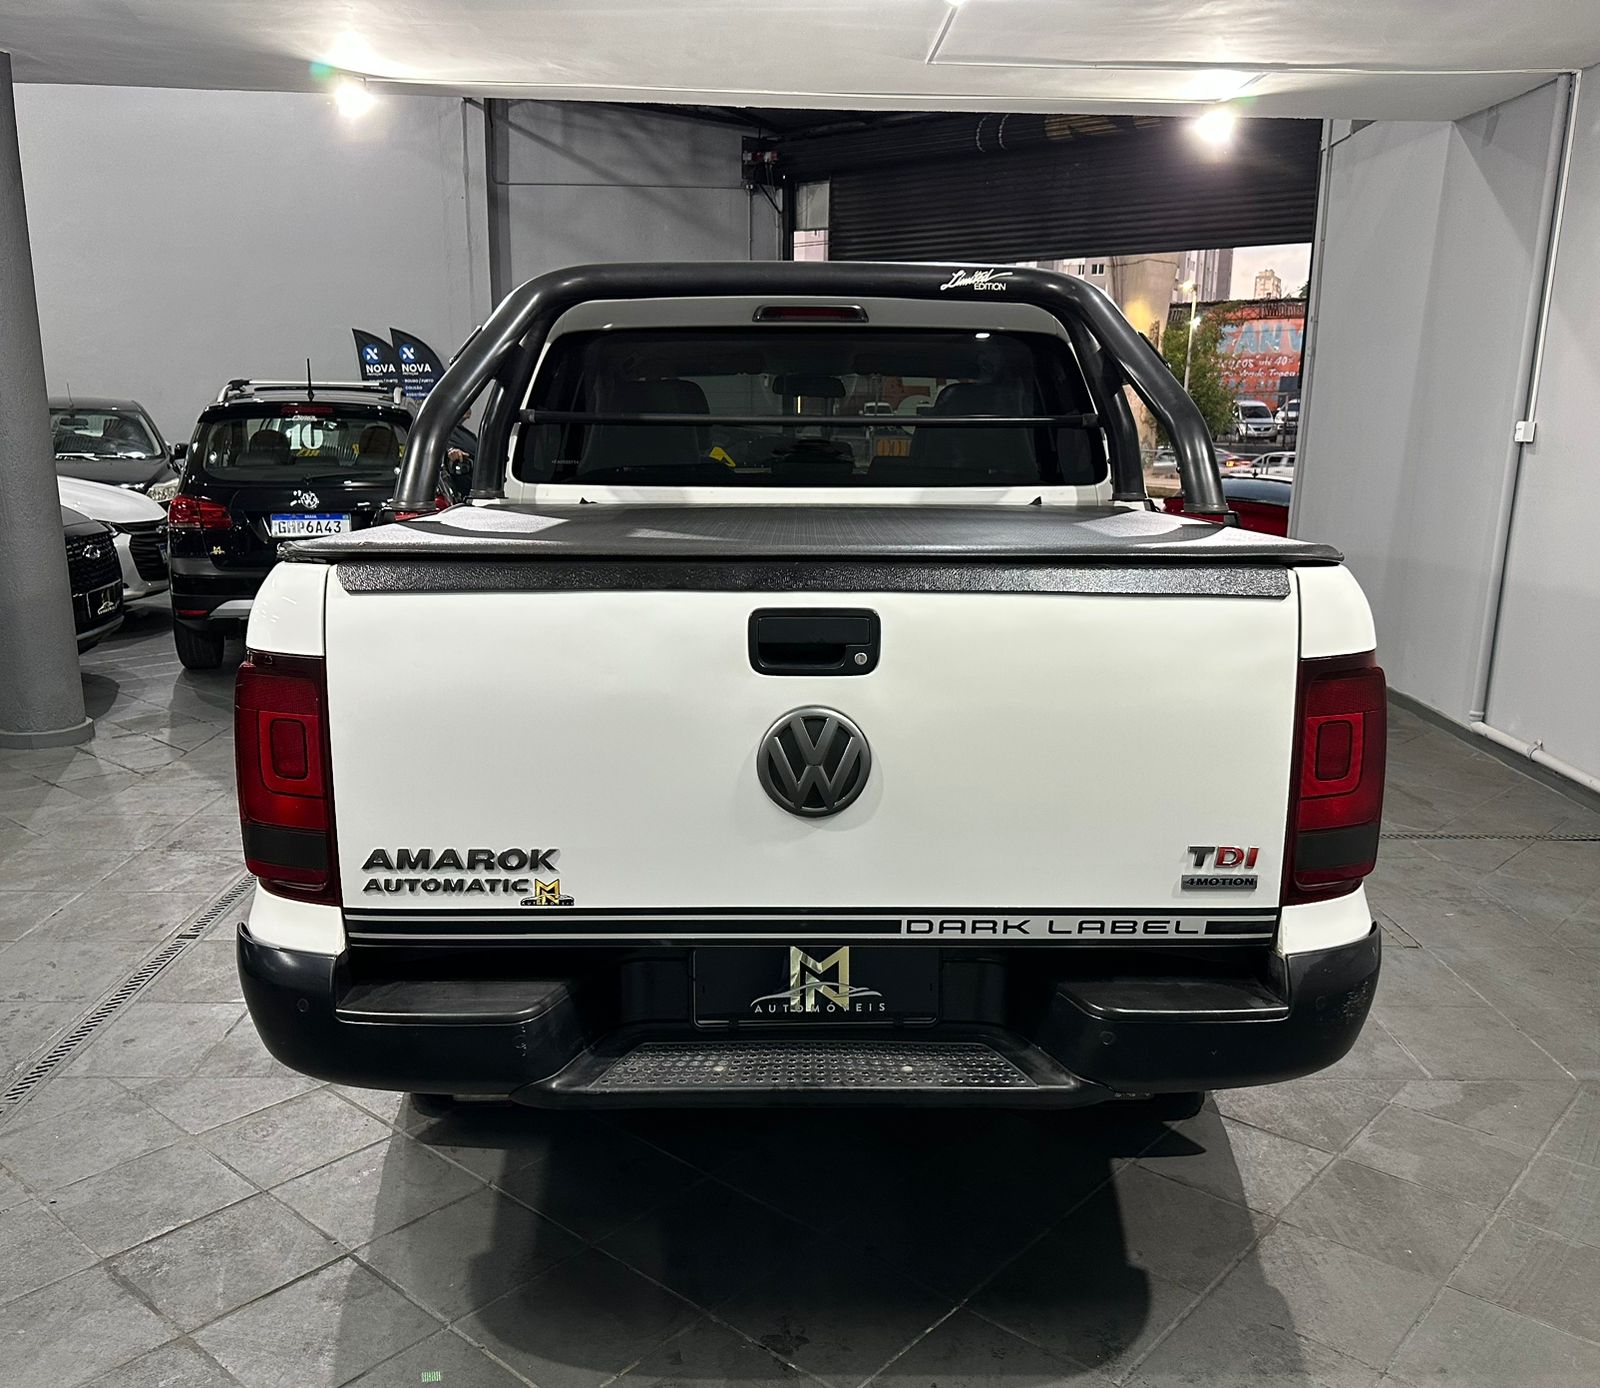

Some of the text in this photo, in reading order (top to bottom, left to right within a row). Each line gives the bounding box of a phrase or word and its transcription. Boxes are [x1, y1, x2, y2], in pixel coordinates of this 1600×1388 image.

[974, 282, 1007, 291] EDITION
[366, 363, 396, 373] NOVA
[401, 363, 432, 373] NOVA
[361, 848, 558, 871] AMAROK
[1188, 845, 1260, 869] TDI
[362, 878, 529, 893] AUTOMATIC
[1186, 877, 1255, 886] 4MOTION
[905, 918, 1200, 935] DARK LABEL
